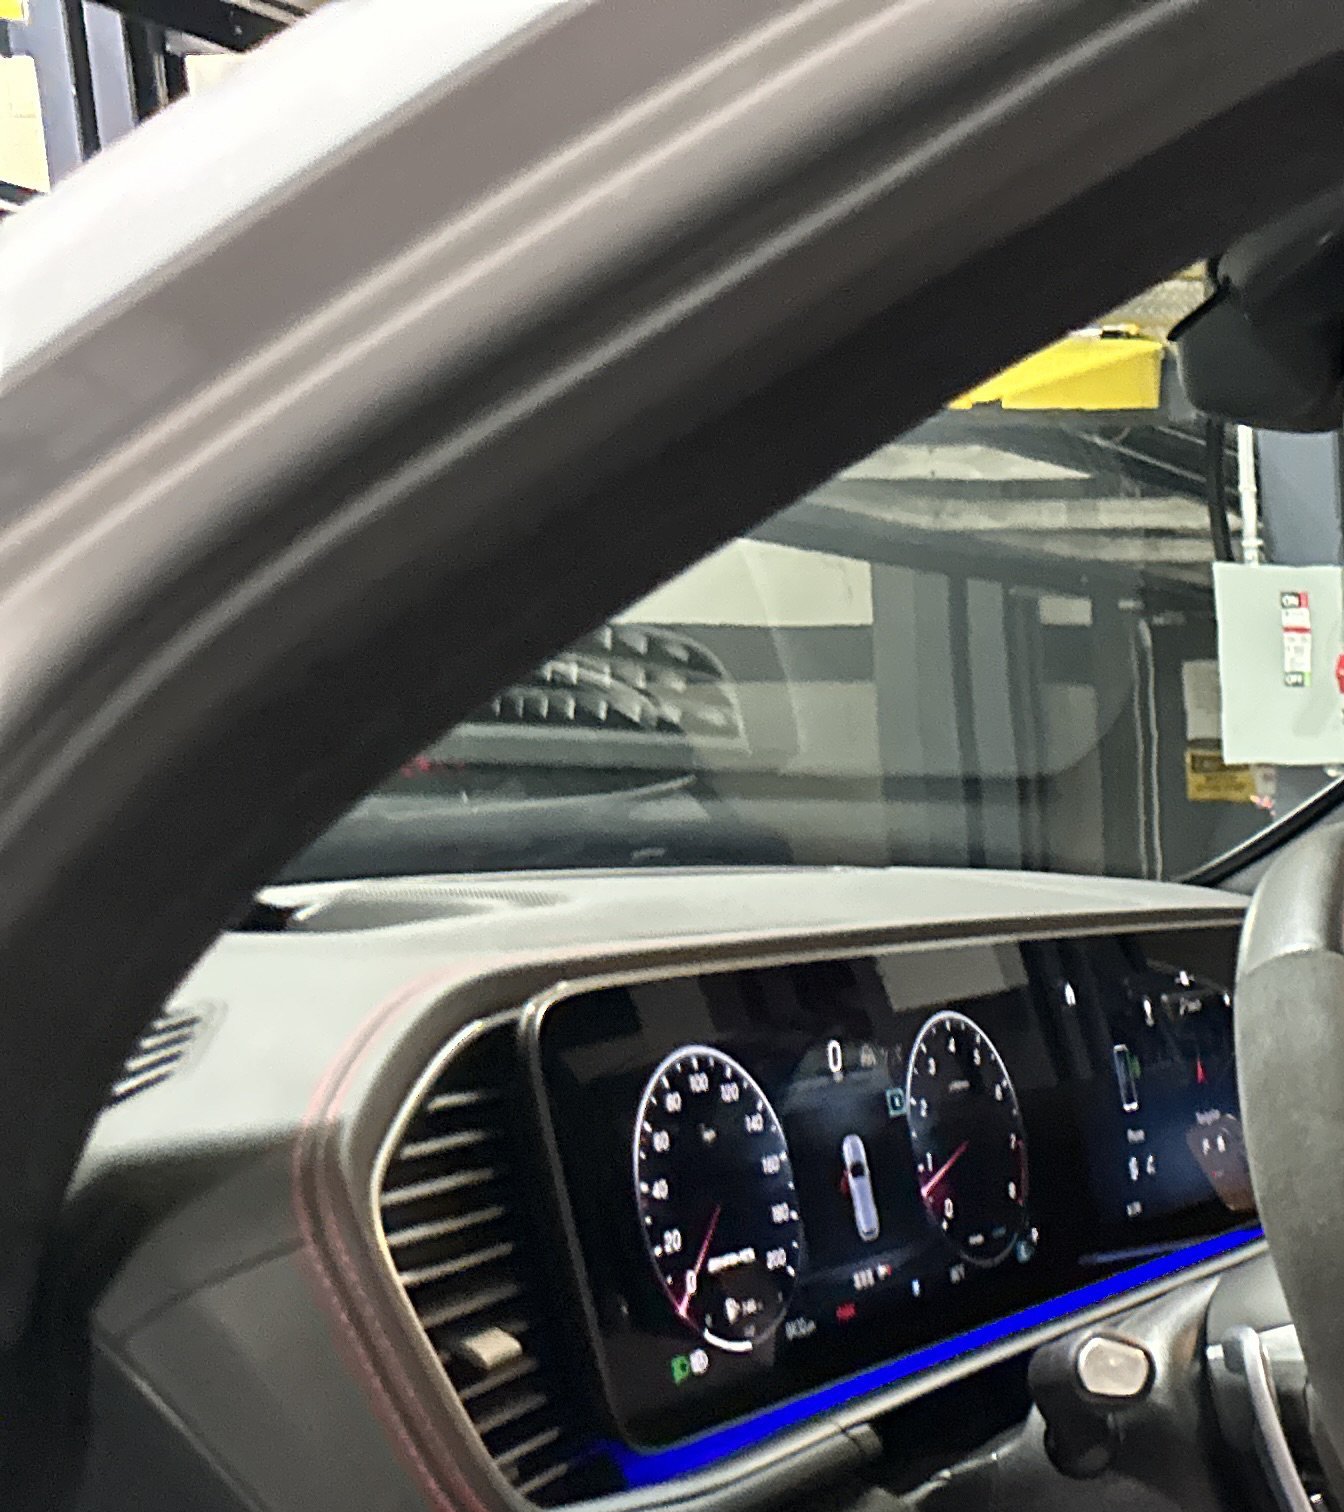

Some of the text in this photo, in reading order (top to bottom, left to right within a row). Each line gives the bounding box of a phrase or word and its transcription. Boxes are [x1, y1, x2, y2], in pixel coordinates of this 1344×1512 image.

[827, 1039, 842, 1073] 0
[944, 1198, 954, 1219] 0
[663, 1228, 682, 1254] 20
[686, 1269, 697, 1295] 0
